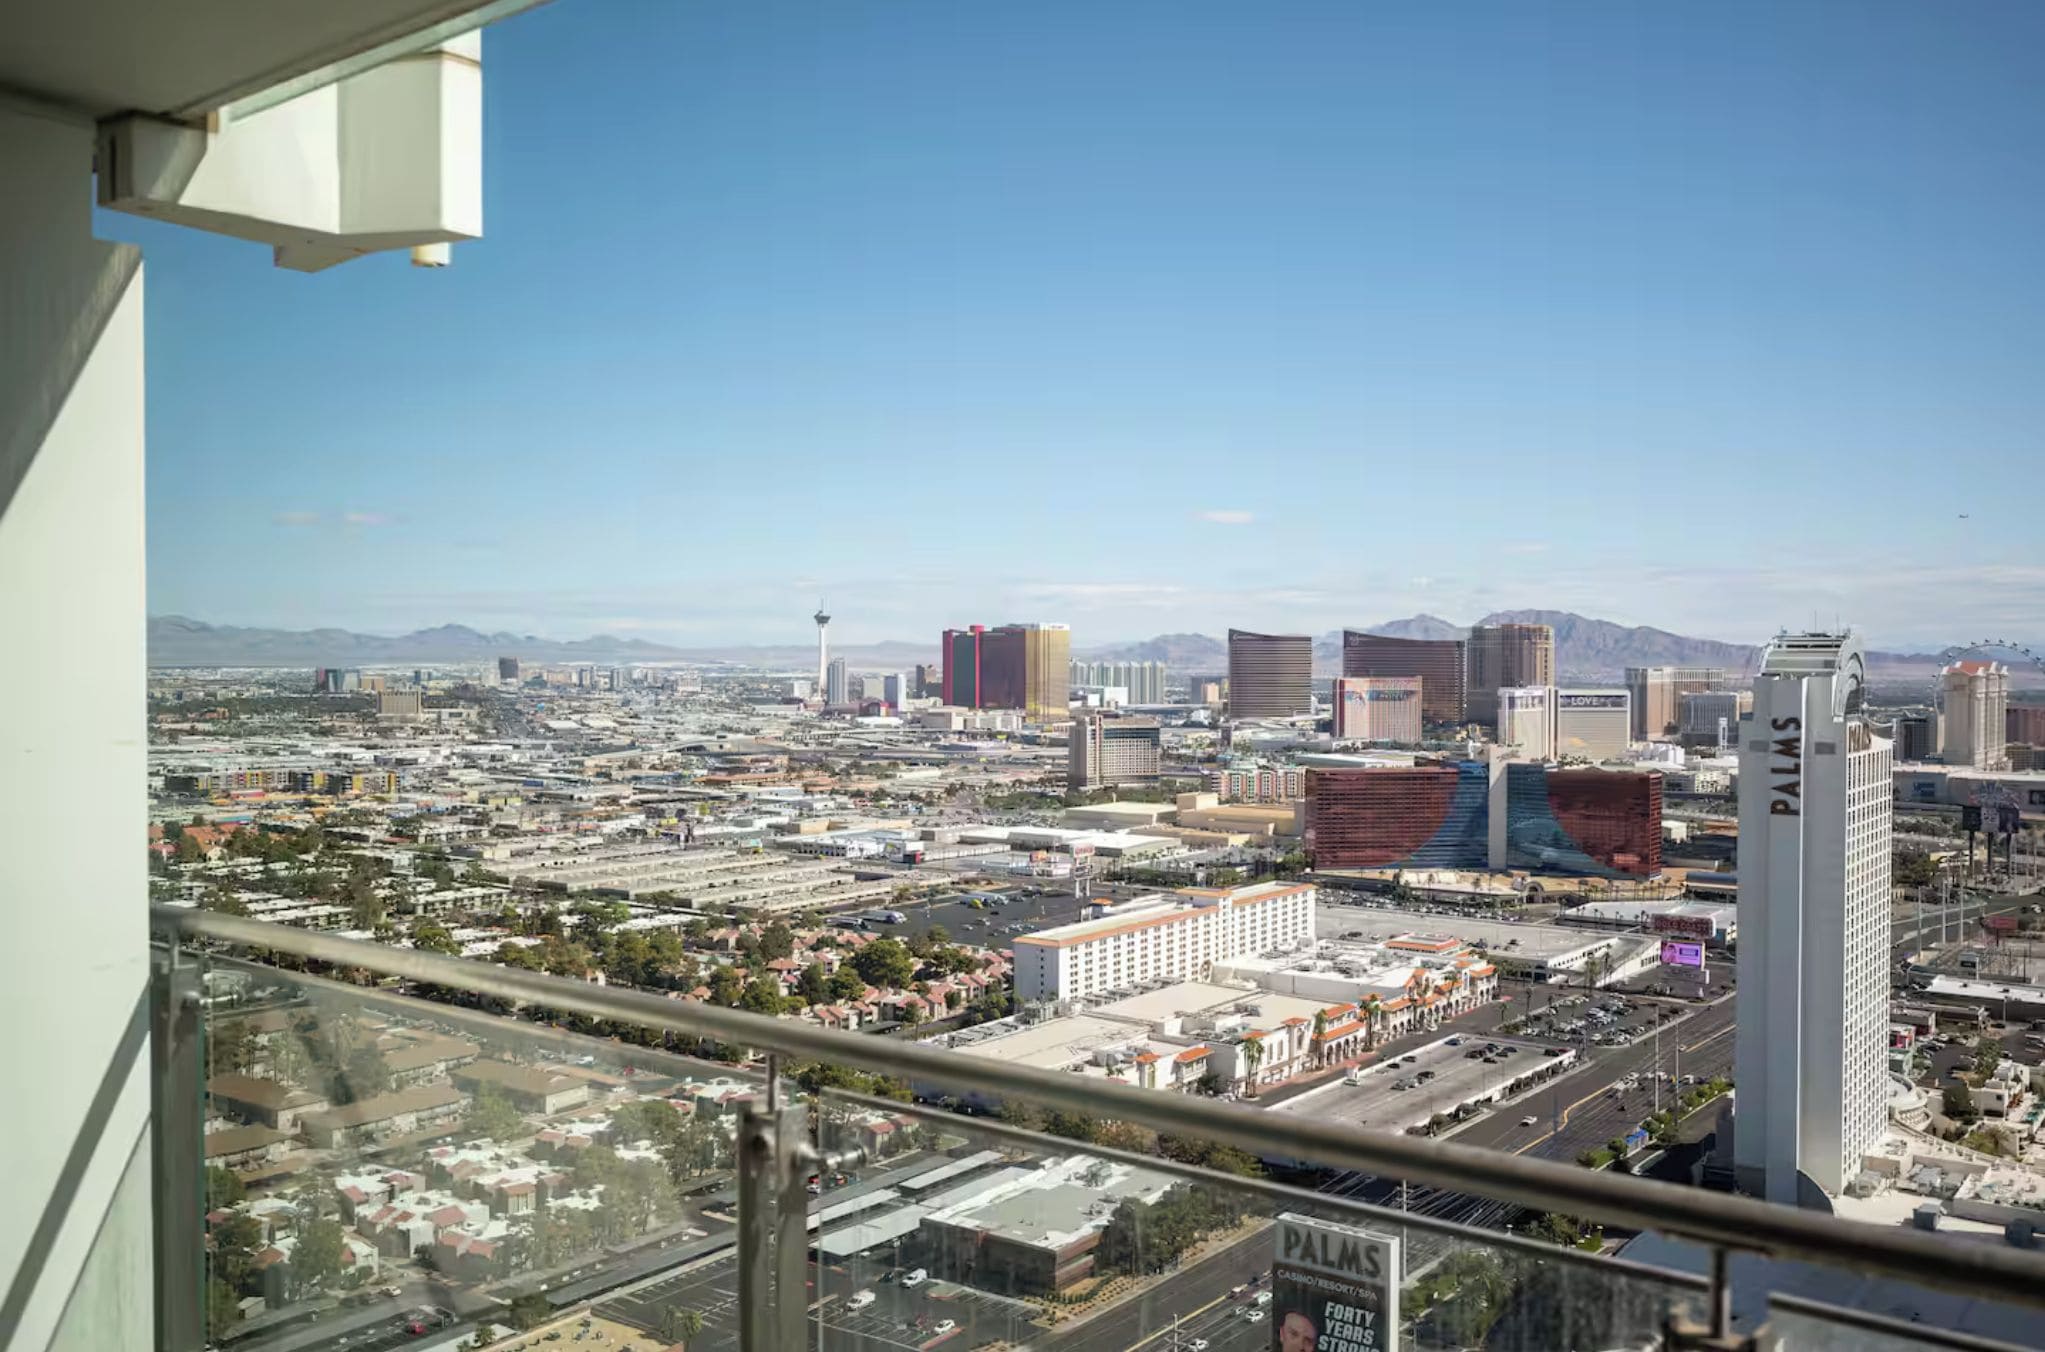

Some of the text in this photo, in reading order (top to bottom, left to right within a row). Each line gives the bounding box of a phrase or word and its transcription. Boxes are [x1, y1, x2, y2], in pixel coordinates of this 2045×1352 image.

[1571, 696, 1598, 705] LOVE
[1770, 717, 1801, 816] PALMS
[1283, 1223, 1380, 1278] PALMS
[1324, 1301, 1376, 1328] FORTY
[1317, 1335, 1380, 1352] STRO
[1325, 1318, 1375, 1345] YEARS
